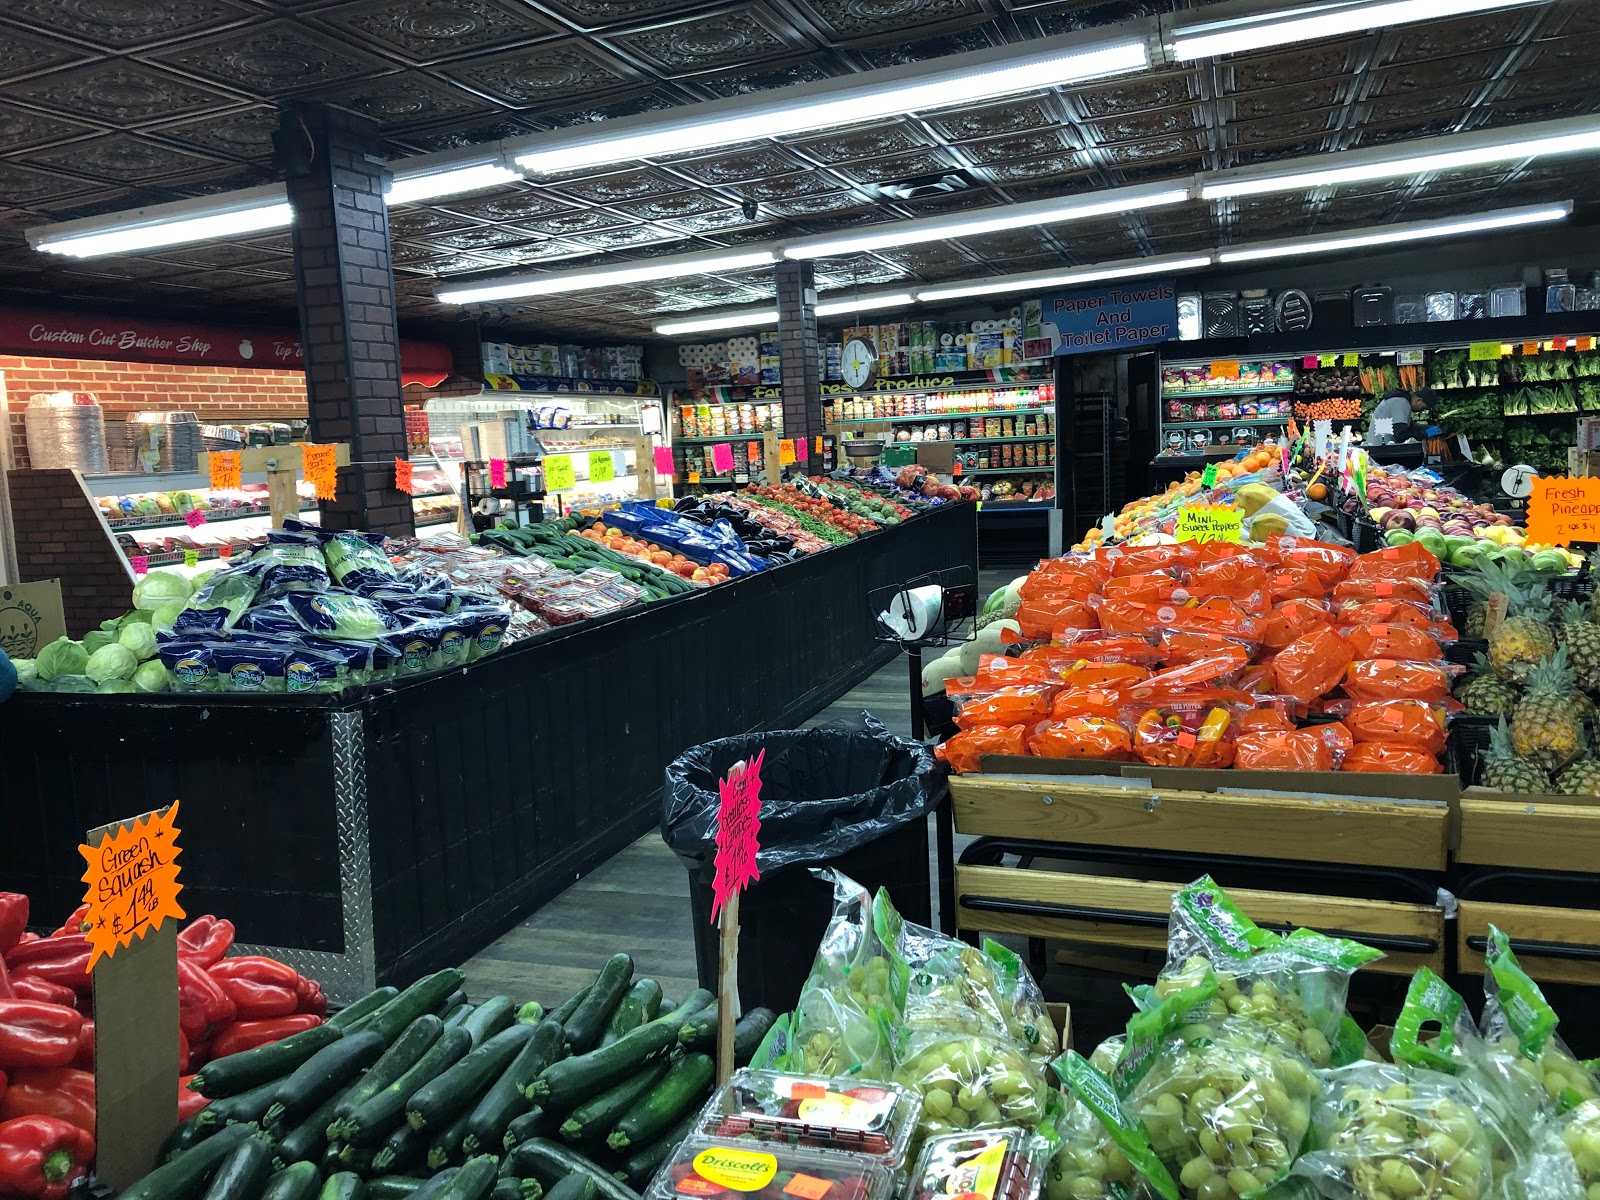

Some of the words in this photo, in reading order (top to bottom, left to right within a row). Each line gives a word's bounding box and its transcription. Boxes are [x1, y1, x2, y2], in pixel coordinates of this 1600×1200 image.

[1054, 296, 1106, 314] Paper
[1110, 285, 1174, 306] Towels
[1096, 308, 1131, 326] And
[29, 324, 84, 343] Custom
[88, 328, 116, 346] Cut
[118, 331, 173, 349] Butcher
[176, 336, 212, 357] Shop
[1062, 329, 1112, 348] Toilet
[1115, 324, 1169, 343] Paper
[1025, 341, 1050, 357] EXIT
[874, 376, 955, 391] Produce
[1545, 487, 1585, 500] Fresh
[17, 600, 42, 623] AQUA
[101, 837, 149, 873] Green
[99, 850, 168, 903] Squash
[701, 1155, 772, 1172] Driscoll's
